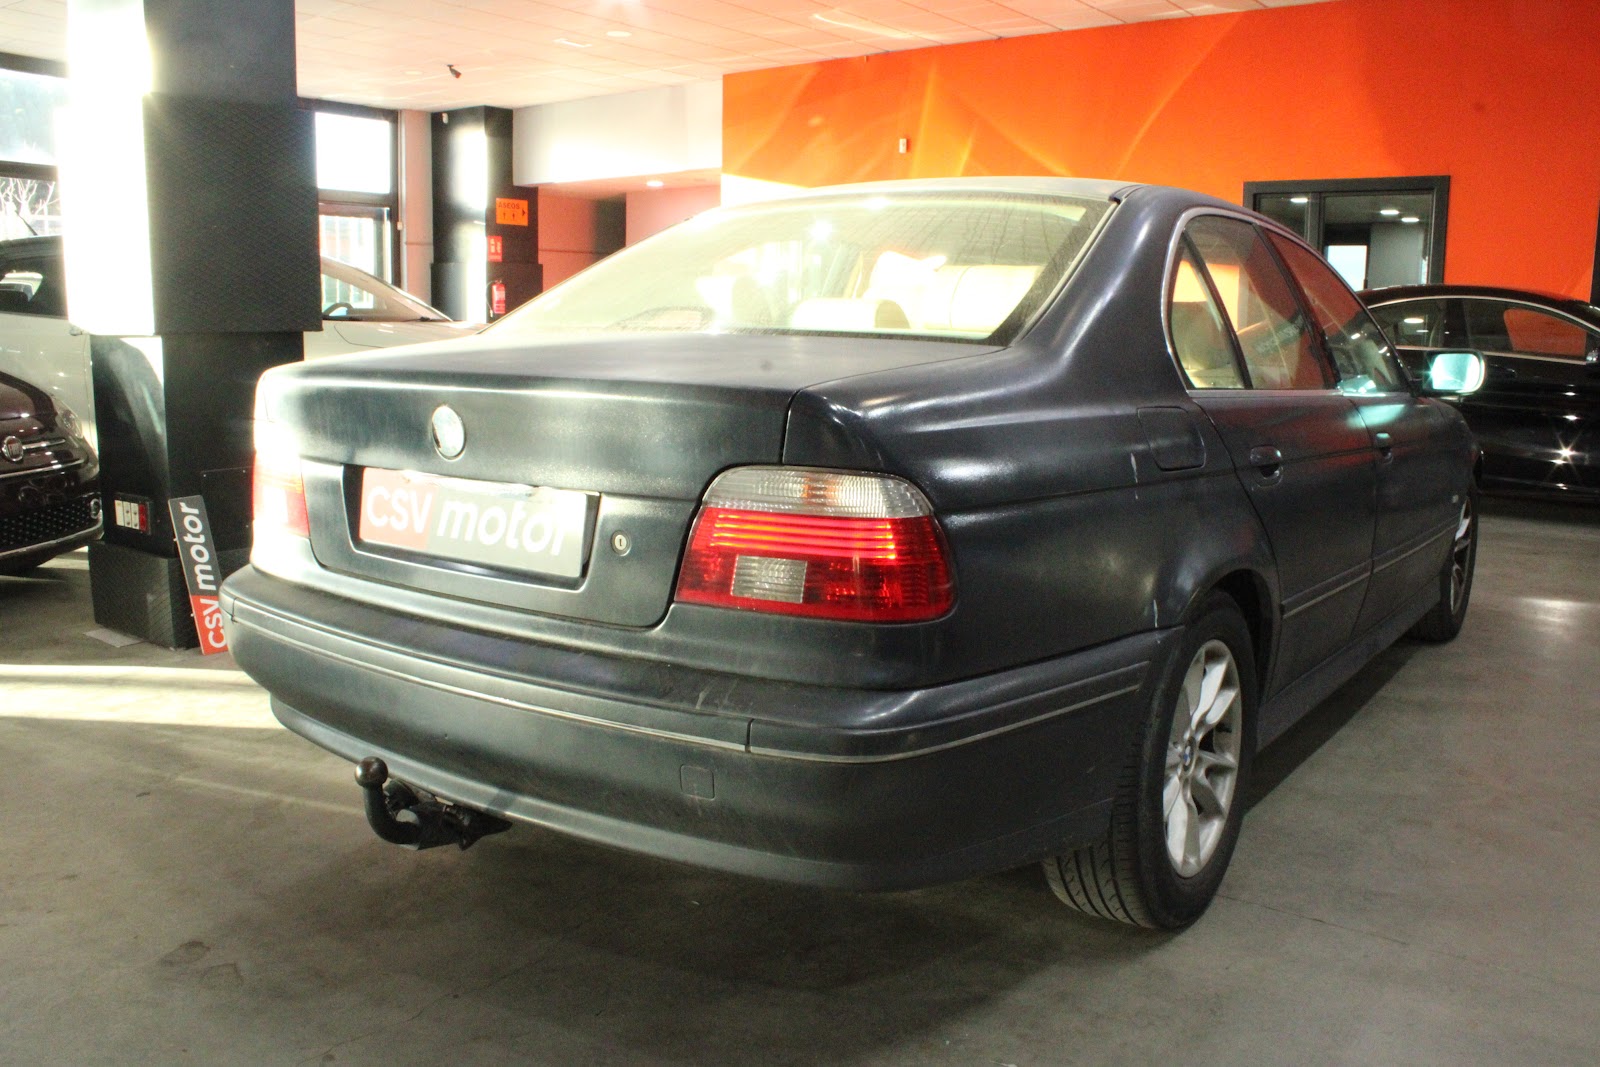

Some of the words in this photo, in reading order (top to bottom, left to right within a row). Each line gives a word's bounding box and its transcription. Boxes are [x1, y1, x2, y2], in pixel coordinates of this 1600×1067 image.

[366, 485, 433, 534] CSV
[179, 502, 217, 591] motor
[200, 598, 227, 648] CSV
